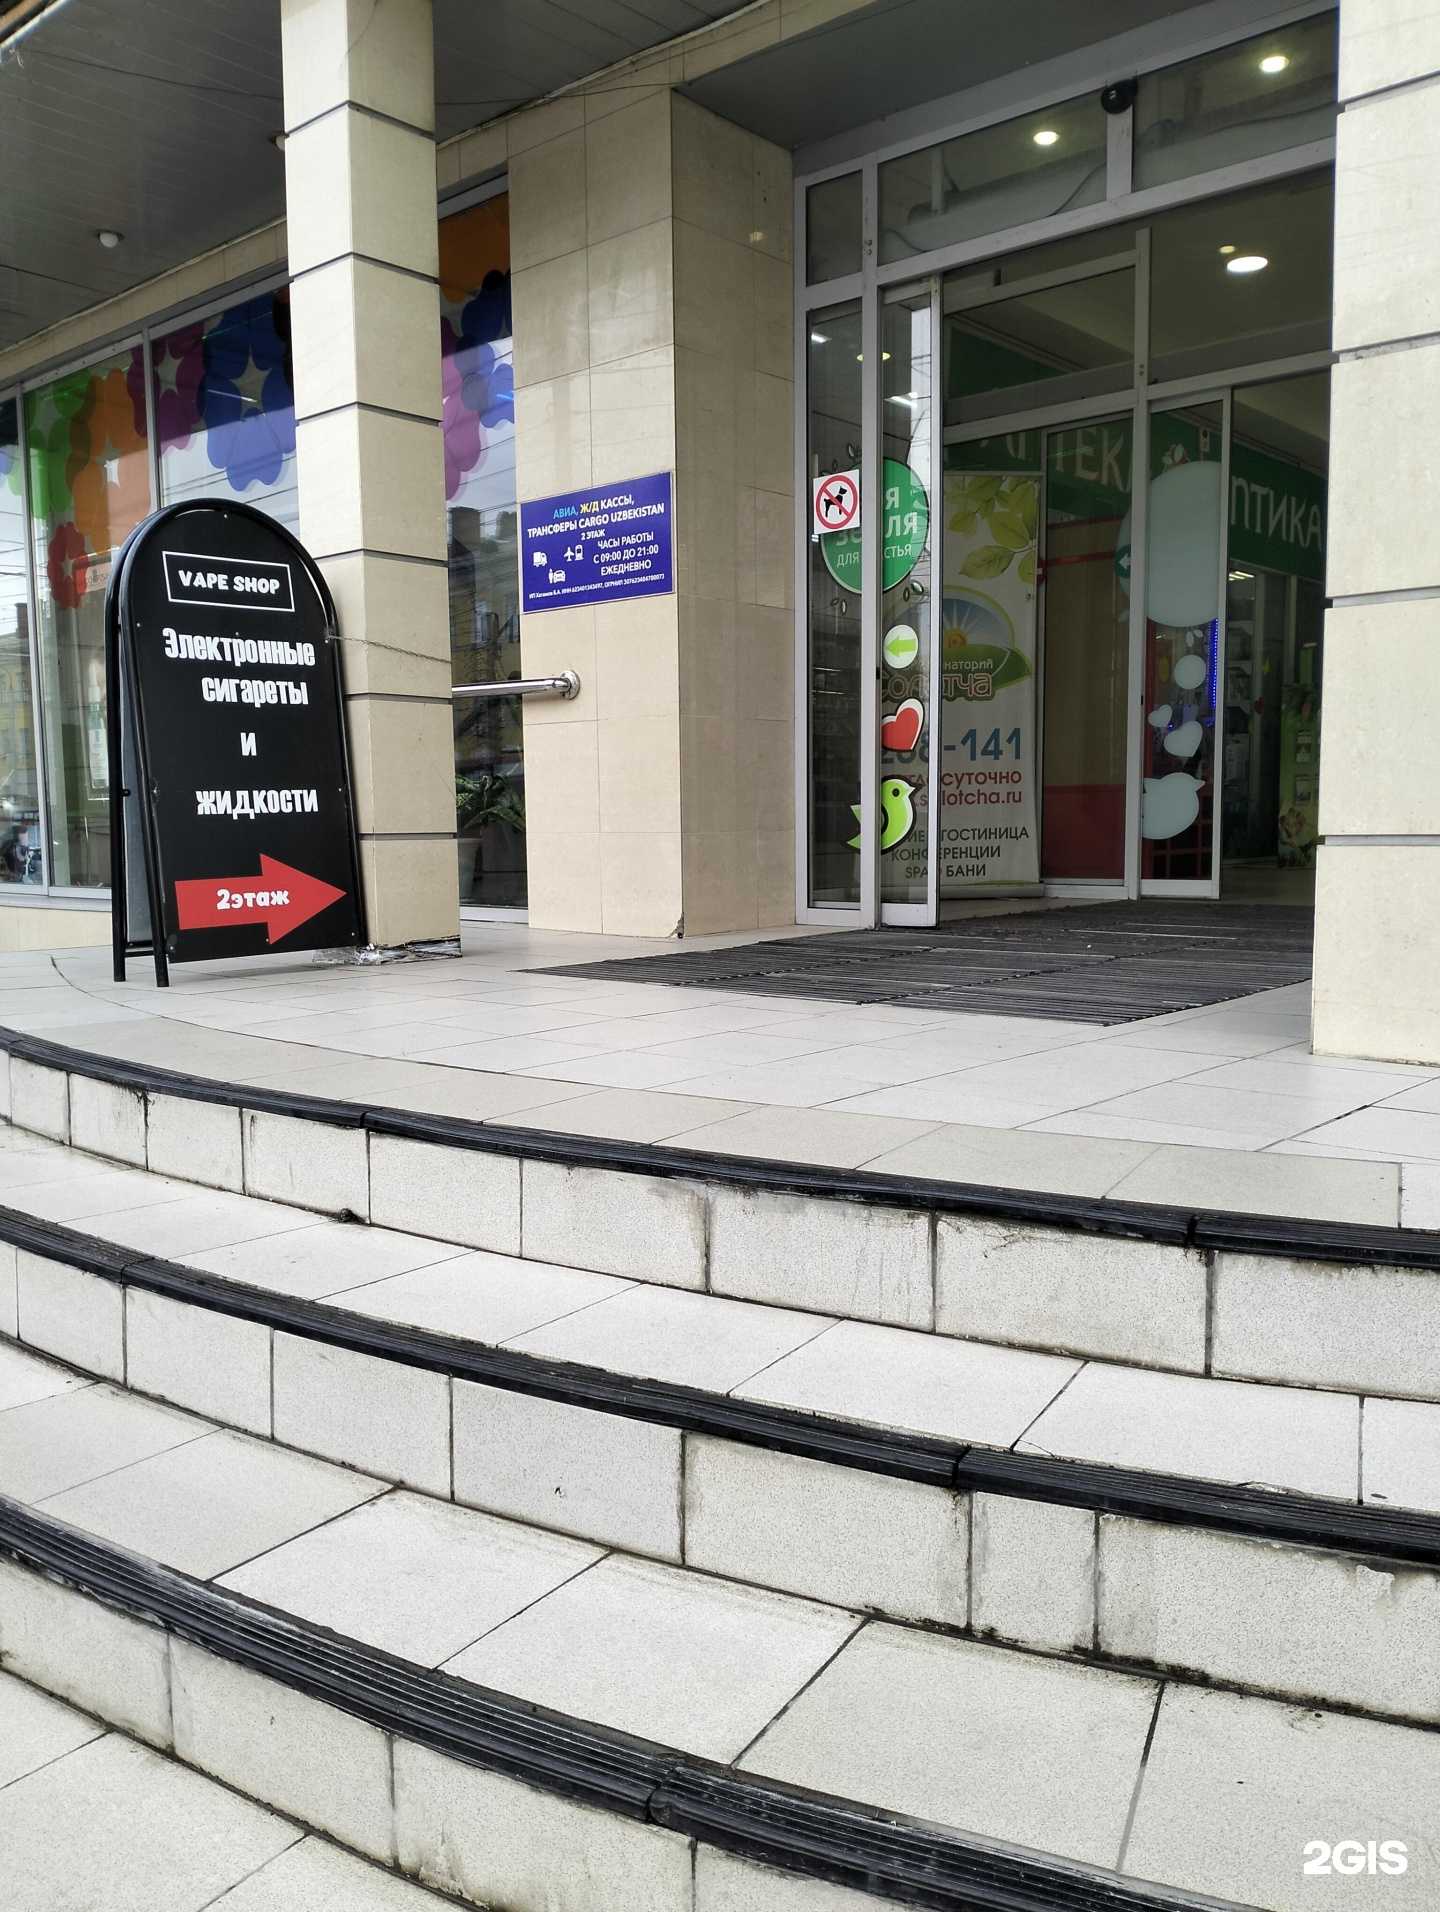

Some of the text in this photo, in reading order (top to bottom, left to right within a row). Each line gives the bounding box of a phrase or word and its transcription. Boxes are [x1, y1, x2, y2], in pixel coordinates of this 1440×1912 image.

[553, 494, 635, 520] АВИА, Ж/Д КАССЫ,
[1230, 475, 1322, 552] ПТИКА
[527, 502, 665, 539] ТРАНСФЕРЫ CARGO UZBEKISTAN
[580, 528, 606, 541] 2 ЭТАЖ
[598, 531, 654, 550] ЧАСЫ РАБОТЫ
[600, 551, 622, 563] 09:00
[622, 548, 636, 561] ДО
[636, 543, 659, 558] 21:00
[600, 559, 652, 576] ЕЖЕДНЕВНО
[178, 570, 280, 594] VAPE SHOP
[162, 628, 316, 667] Электронные
[201, 676, 308, 707] сигареты
[196, 789, 318, 819] жидкости
[945, 864, 987, 877] БАНИ
[216, 888, 290, 911] 2этаж
